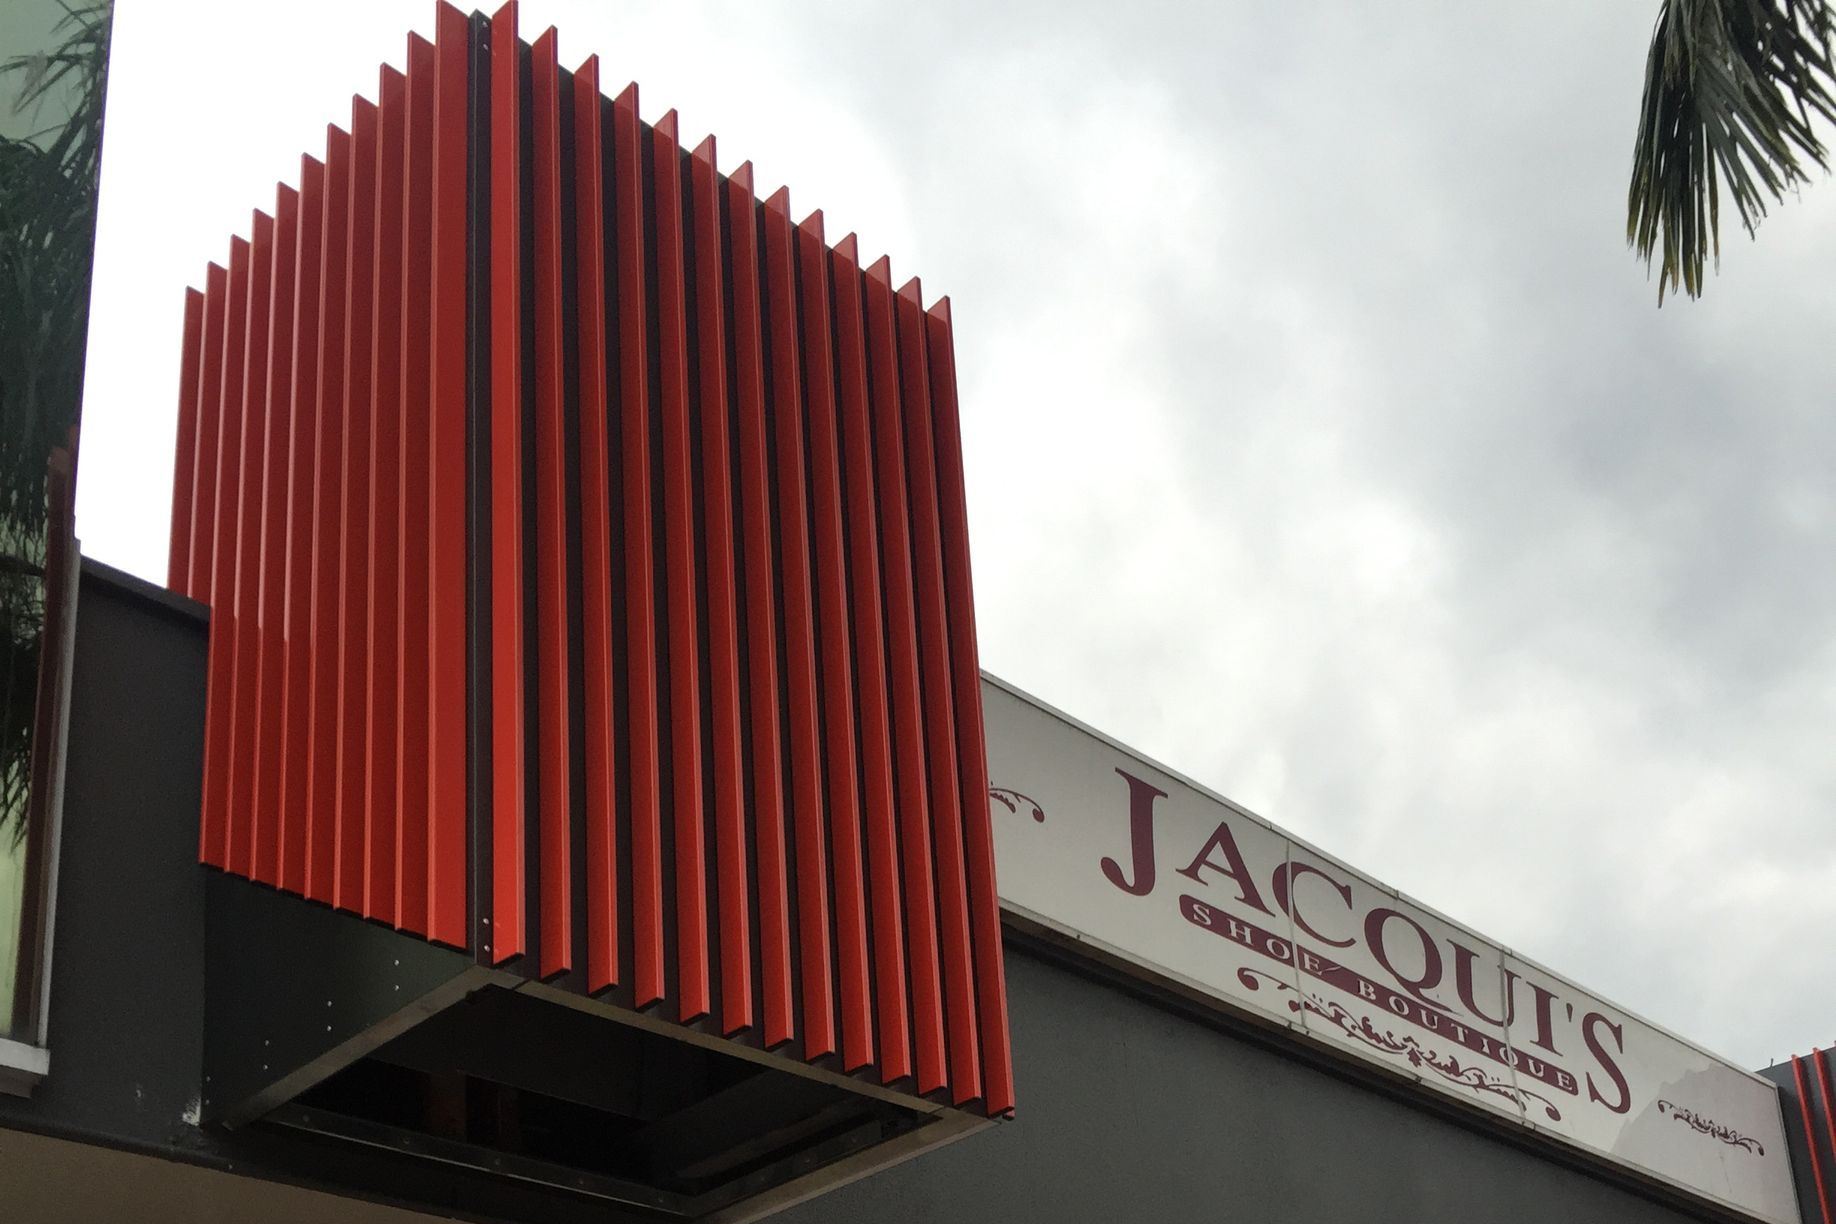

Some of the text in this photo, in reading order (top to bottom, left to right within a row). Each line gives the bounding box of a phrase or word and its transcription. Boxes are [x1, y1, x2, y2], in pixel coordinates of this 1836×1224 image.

[1100, 767, 1632, 1114] JACQUI'S
[1192, 902, 1577, 1093] SHOE BOUTIQUE
